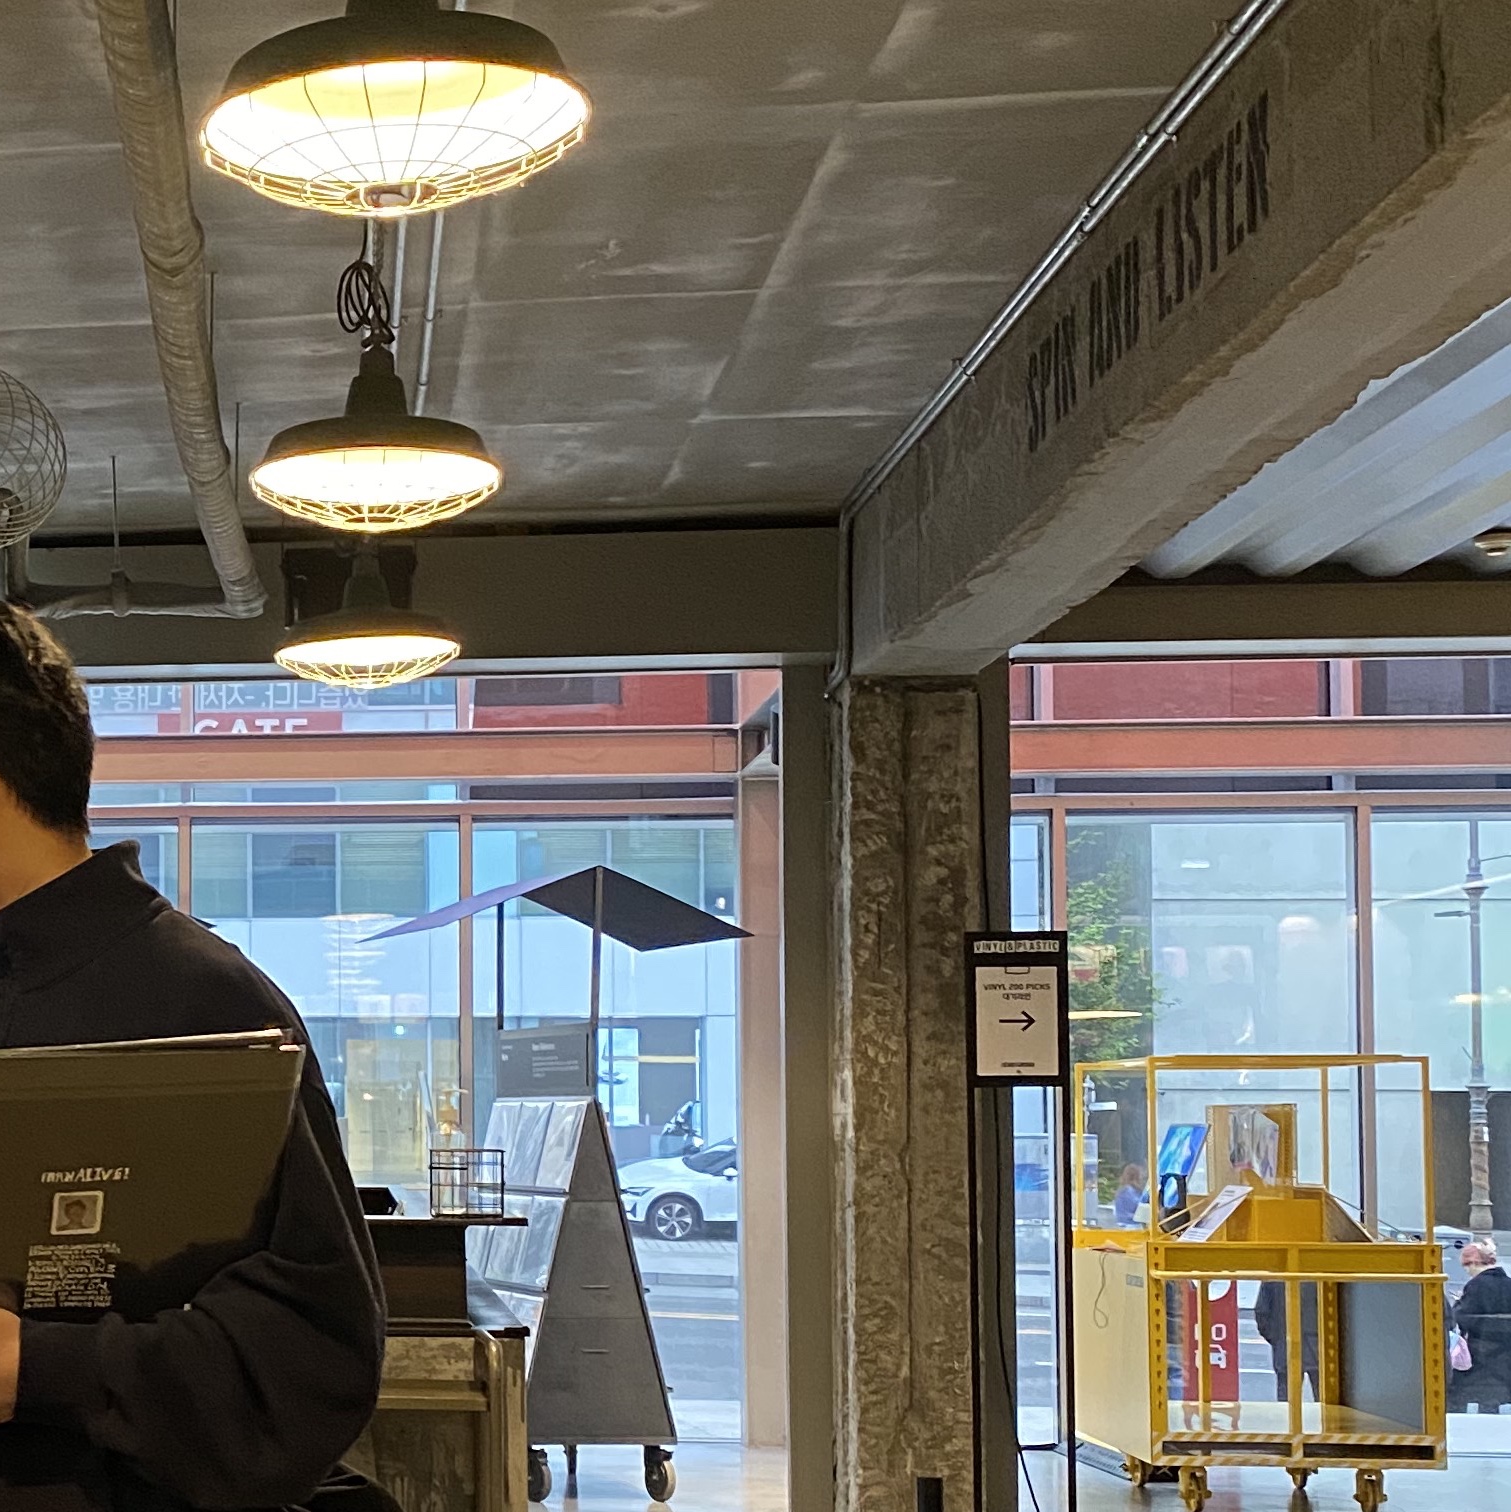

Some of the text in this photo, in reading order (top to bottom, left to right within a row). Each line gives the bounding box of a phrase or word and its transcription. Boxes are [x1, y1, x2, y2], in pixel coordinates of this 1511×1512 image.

[1028, 304, 1077, 453] SPIN
[1155, 88, 1270, 323] LISTEN
[1016, 940, 1059, 952] PLASTIC
[983, 983, 1051, 991] VINYL 200 PICKS
